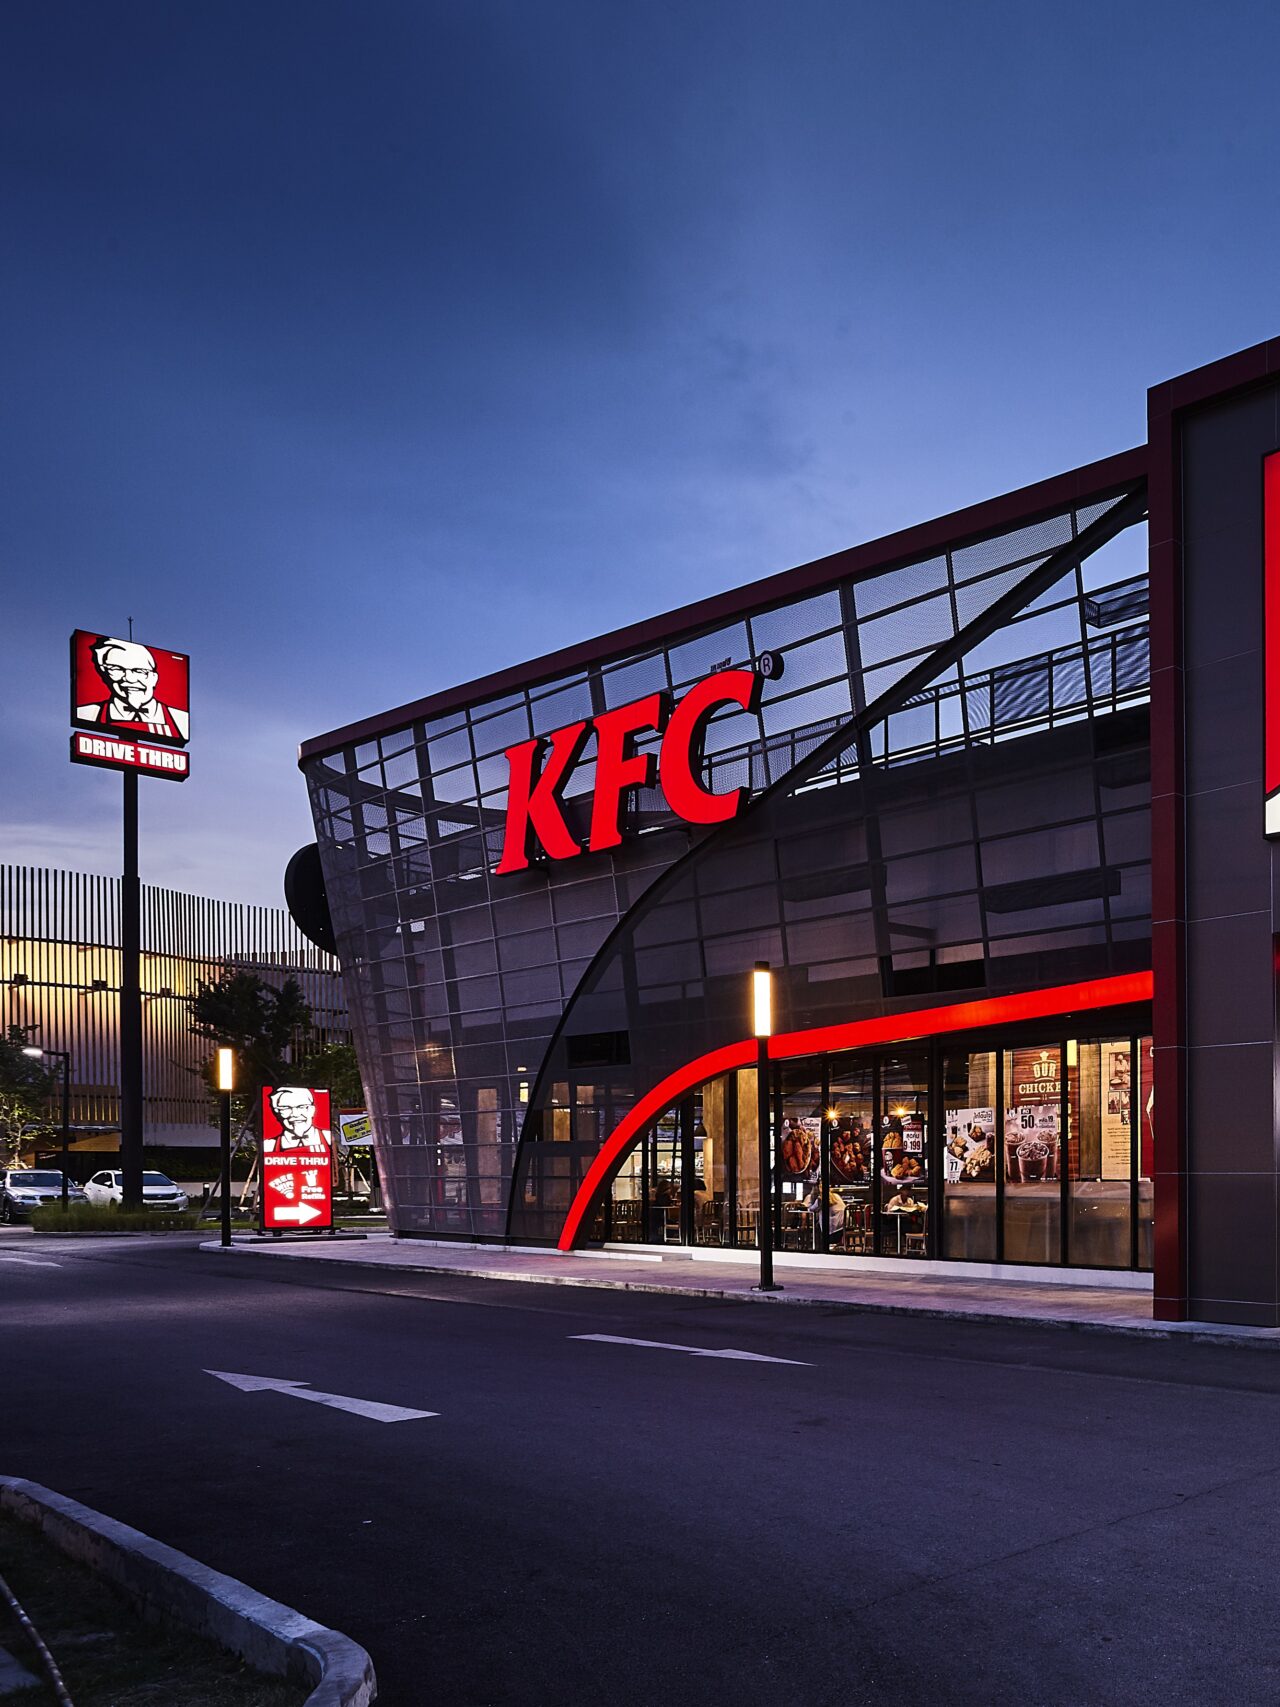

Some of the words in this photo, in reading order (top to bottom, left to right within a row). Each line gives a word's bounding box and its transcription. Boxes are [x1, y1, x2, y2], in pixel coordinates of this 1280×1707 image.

[79, 736, 135, 762] DRIVE
[137, 747, 187, 771] THRU
[494, 669, 756, 876] KFC
[1033, 1062, 1057, 1078] OUR
[1021, 1114, 1035, 1129] 50
[264, 1156, 298, 1166] DRIVE
[298, 1156, 329, 1166] THRU
